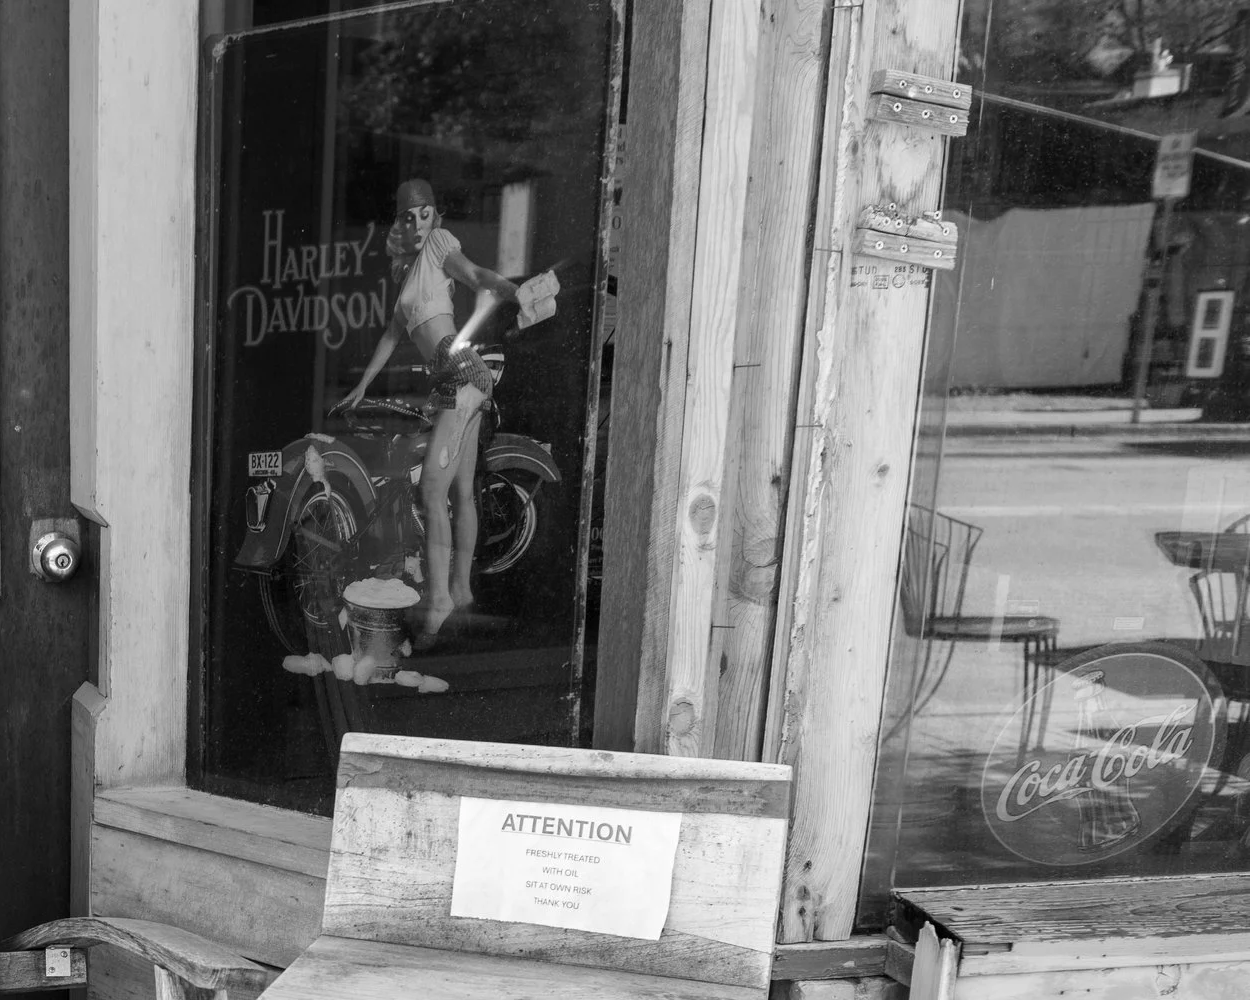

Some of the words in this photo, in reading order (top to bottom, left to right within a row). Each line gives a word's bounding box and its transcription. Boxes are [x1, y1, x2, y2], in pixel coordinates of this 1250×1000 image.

[226, 277, 388, 350] DAVIDSON
[501, 813, 633, 844] ATTENTION
[525, 848, 563, 859] FRESHLY
[563, 852, 601, 864] TREATED
[542, 866, 563, 877] WITH
[564, 868, 579, 878] OIL
[525, 880, 539, 889] SIT
[539, 882, 549, 890] AT
[550, 883, 572, 894] OWN
[573, 885, 592, 896] RISK
[534, 896, 560, 908] THANK
[561, 899, 580, 910] YOU
